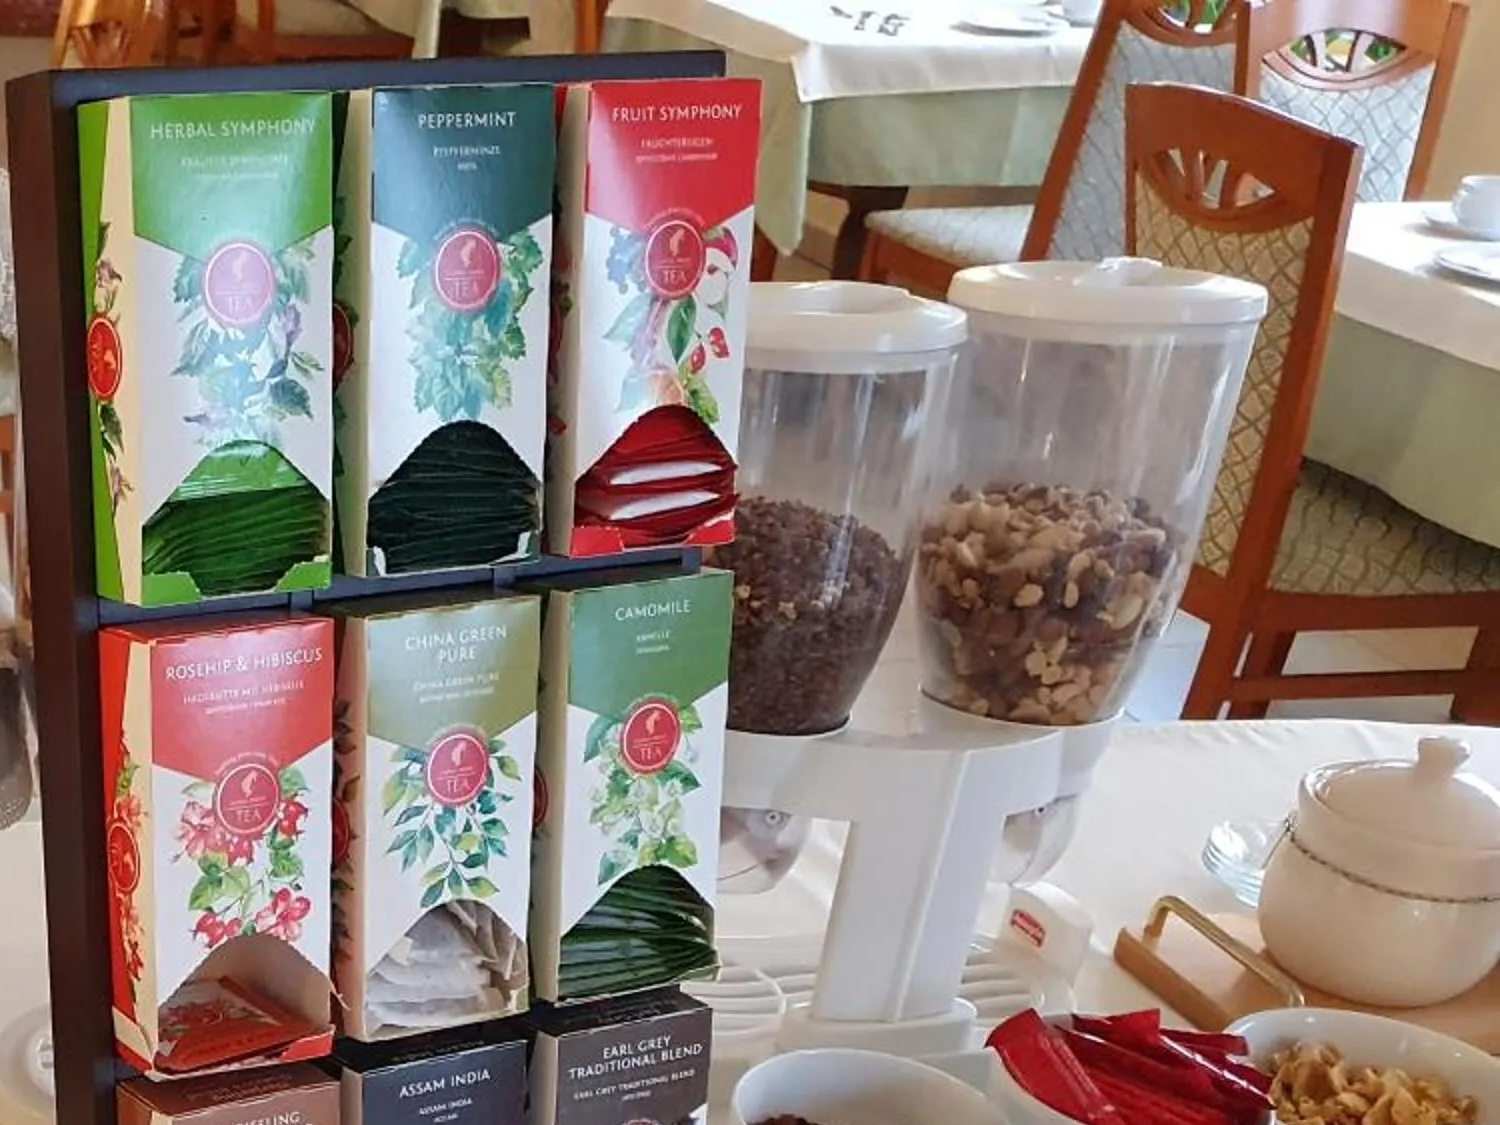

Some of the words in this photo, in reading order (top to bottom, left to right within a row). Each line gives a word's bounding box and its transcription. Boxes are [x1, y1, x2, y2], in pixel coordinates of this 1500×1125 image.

[417, 111, 517, 129] PEPPERMINT
[612, 106, 657, 123] FRUIT
[659, 103, 743, 121] SYMPHONY
[150, 121, 216, 141] HERBAL
[220, 118, 316, 138] SYMPHONY
[614, 599, 692, 621] CAMOMILE
[404, 631, 456, 651] CHINA
[459, 624, 507, 643] GREEN
[165, 658, 233, 681] ROSEHIP
[236, 655, 248, 672] &
[252, 647, 323, 669] HIBISCUS
[439, 645, 478, 662] PURE
[639, 746, 662, 761] TEA
[445, 778, 471, 793] TEA
[237, 808, 262, 822] TEA
[603, 1043, 635, 1060] EARL
[638, 1034, 672, 1053] GREY
[567, 1053, 657, 1080] TRADITIONAL
[660, 1043, 704, 1062] BLEND
[399, 1077, 445, 1099] ASSAM
[450, 1068, 491, 1087] INDIA
